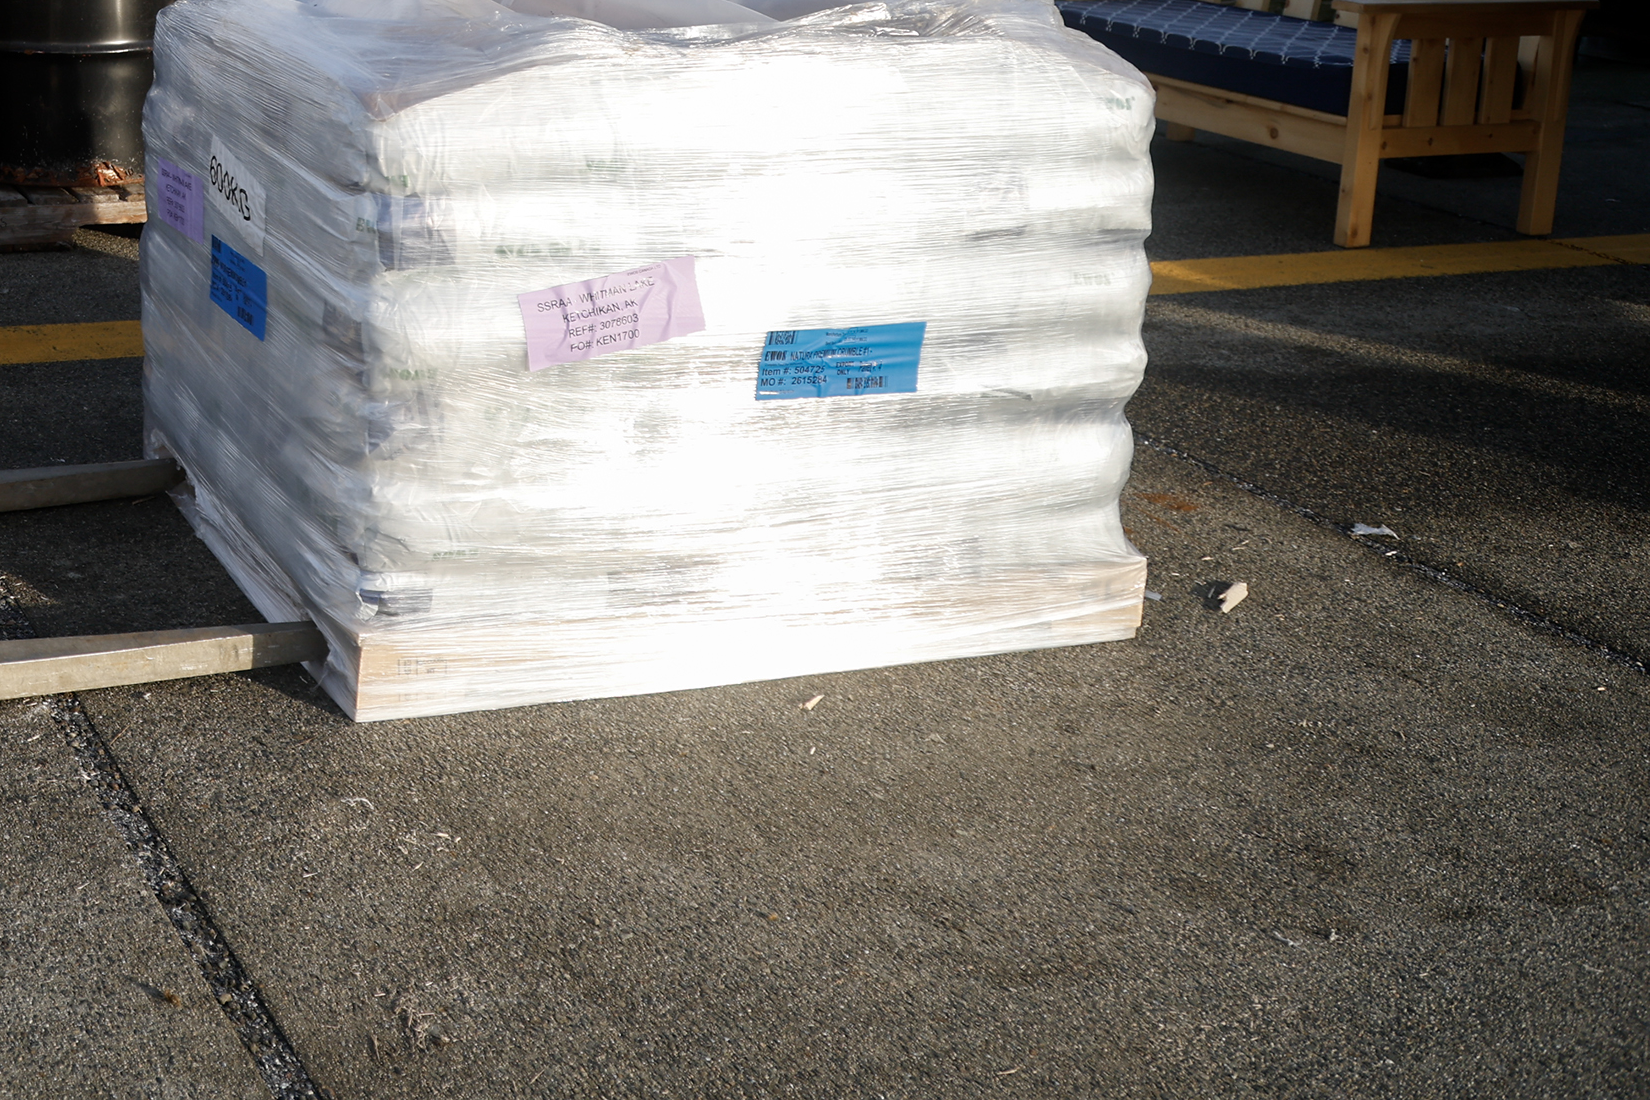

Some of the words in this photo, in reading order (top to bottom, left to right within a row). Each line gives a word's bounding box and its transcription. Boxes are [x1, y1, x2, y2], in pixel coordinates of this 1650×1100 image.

[209, 155, 251, 221] 600KG
[536, 297, 573, 313] SSRAA
[578, 284, 628, 304] WHITMAN
[628, 276, 656, 292] LAKE
[624, 298, 639, 309] AK
[568, 323, 597, 338] REF#:
[599, 313, 640, 331] 3078603
[596, 328, 640, 347] KEN1700
[764, 350, 788, 362] EWOS
[762, 368, 781, 376] Item
[783, 366, 792, 375] #:
[760, 378, 776, 387] MO
[777, 377, 787, 386] #:
